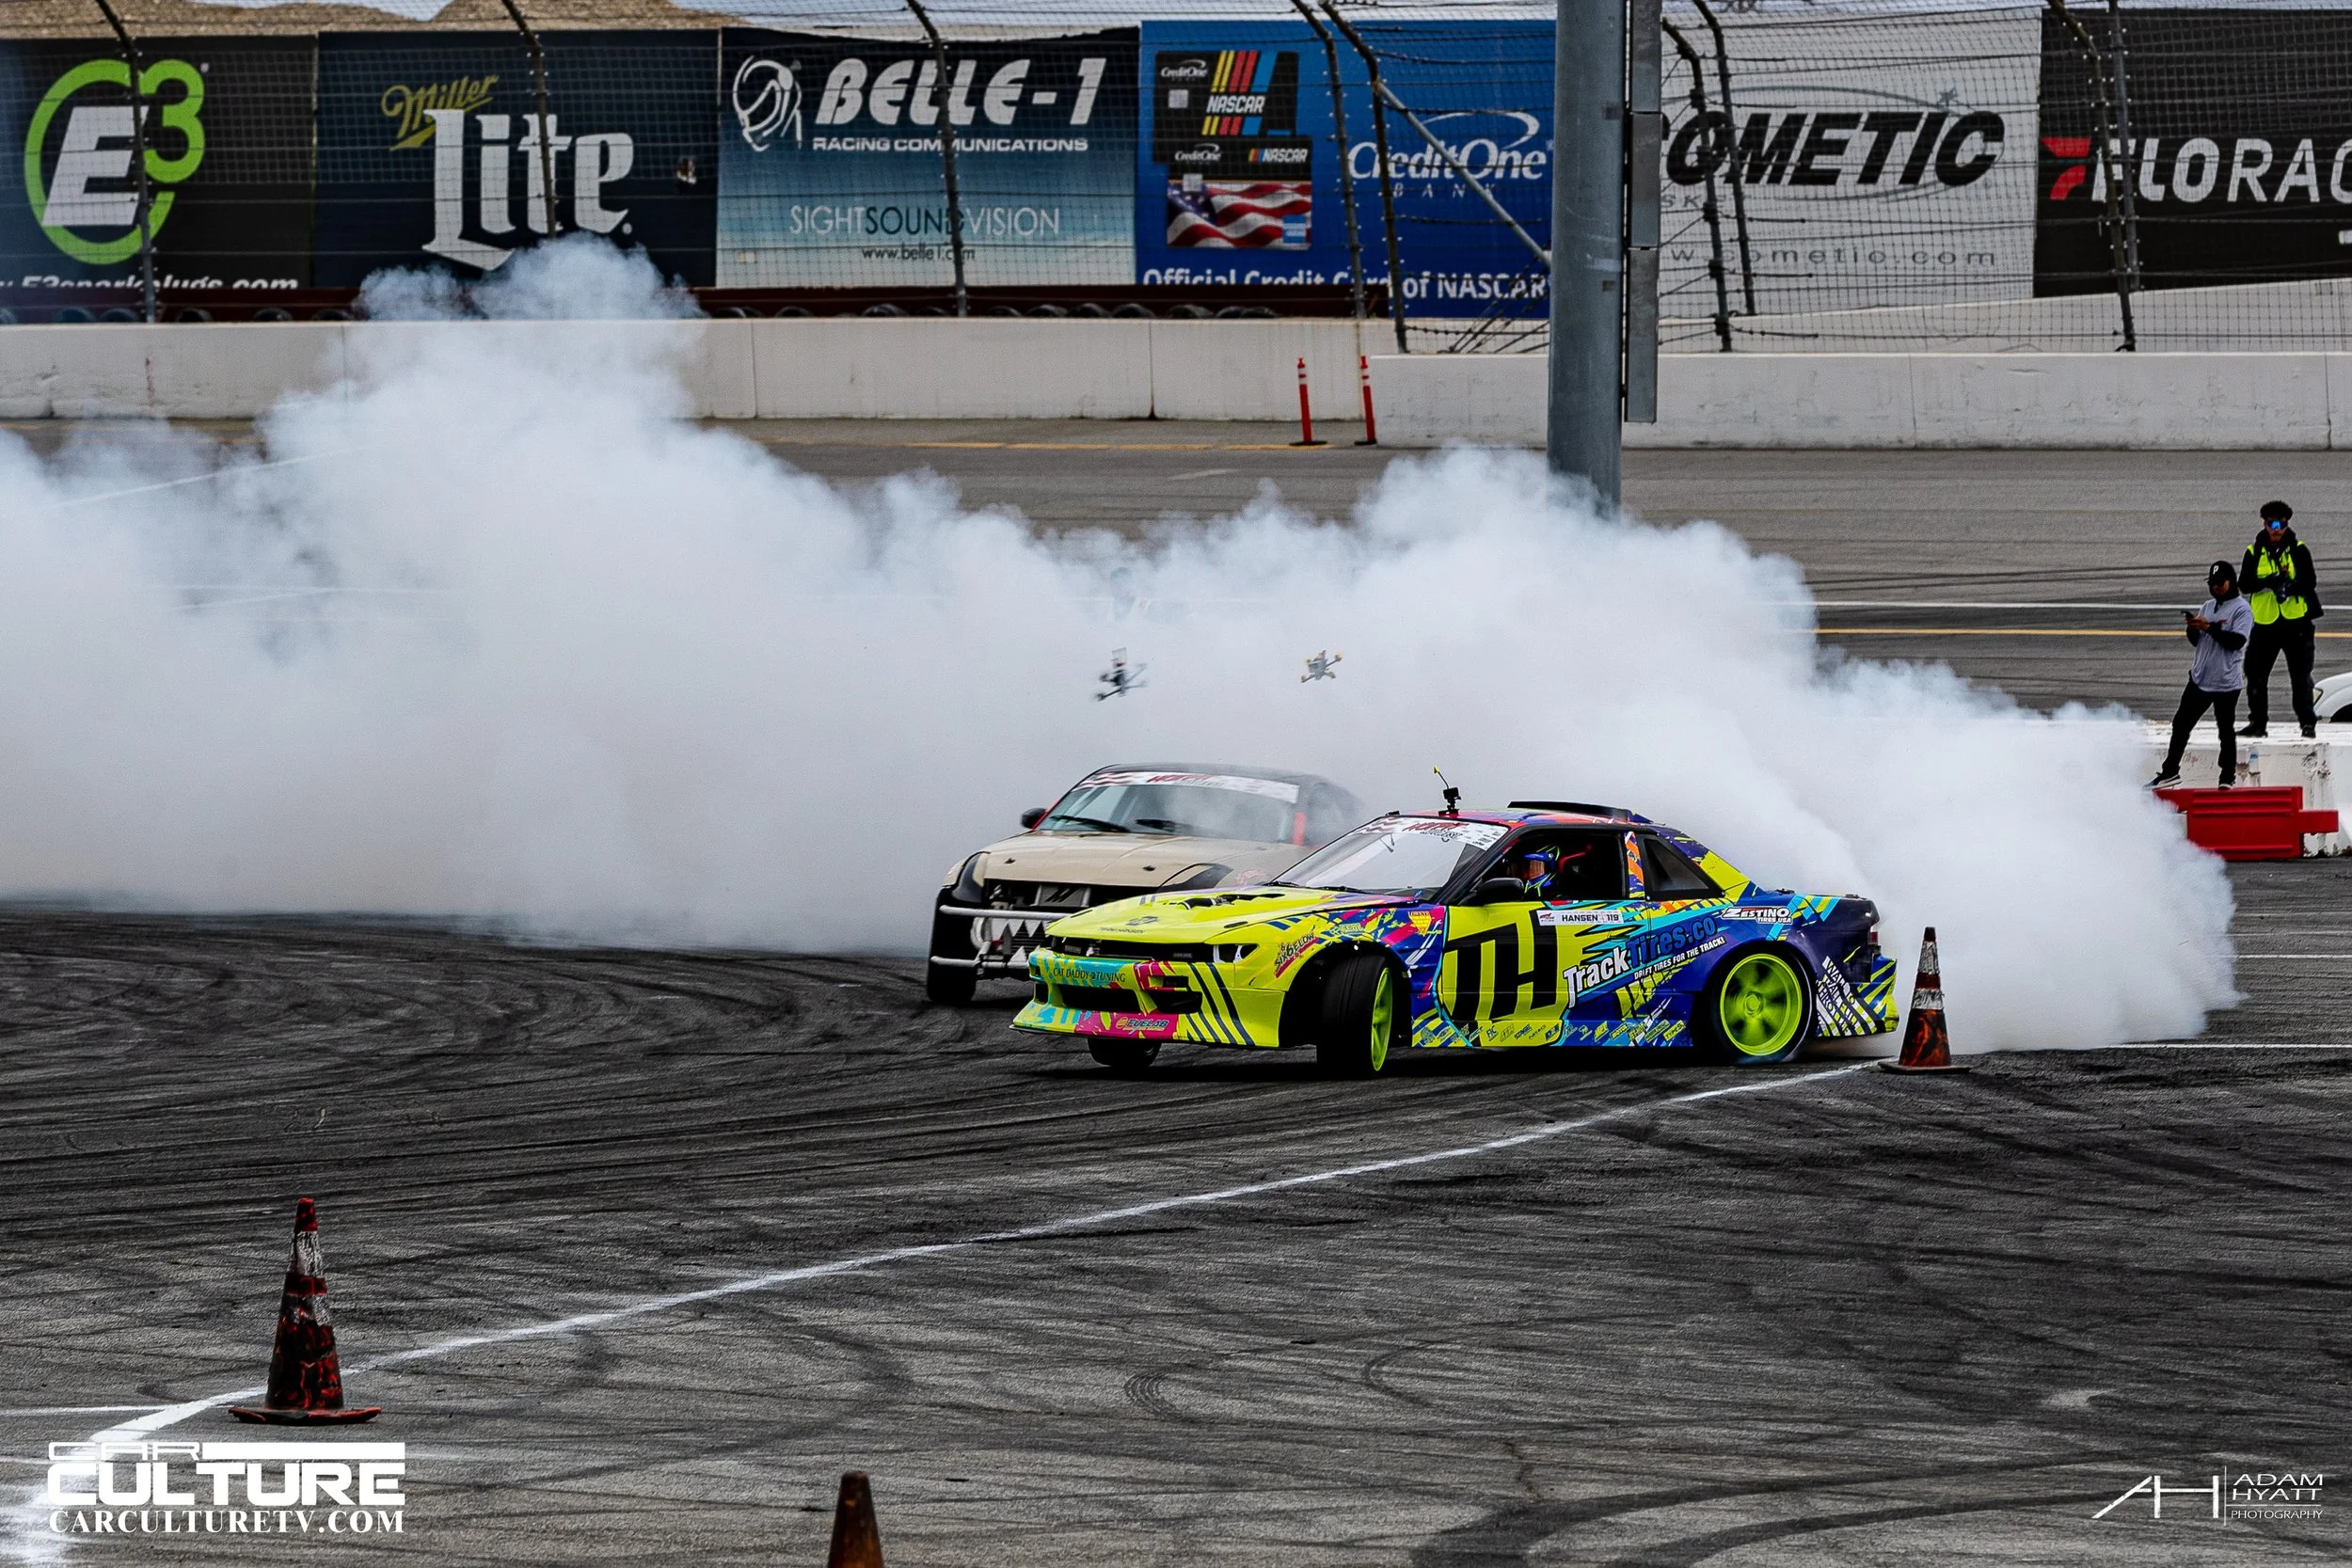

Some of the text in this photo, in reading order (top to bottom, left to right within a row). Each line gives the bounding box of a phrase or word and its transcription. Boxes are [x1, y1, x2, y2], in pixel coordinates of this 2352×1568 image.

[815, 57, 1106, 125] BELLE-1
[381, 74, 500, 141] Miller
[1206, 95, 1265, 114] NASCAR
[812, 137, 890, 151] RACING
[1661, 110, 2006, 187] OMETIC
[1262, 149, 1308, 162] NASCAR
[422, 108, 634, 271] Lite
[862, 243, 976, 261] www.belle1.cm
[1402, 271, 1431, 299] of
[1438, 272, 1547, 299] NASCAR
[1606, 913, 1619, 922] 119
[1723, 908, 1790, 918] ZESTINO
[1634, 936, 1725, 980] DRIFT TIRES FOR THE TRACK!
[1066, 968, 1089, 979] DADDY
[1095, 972, 1126, 983] TUNING
